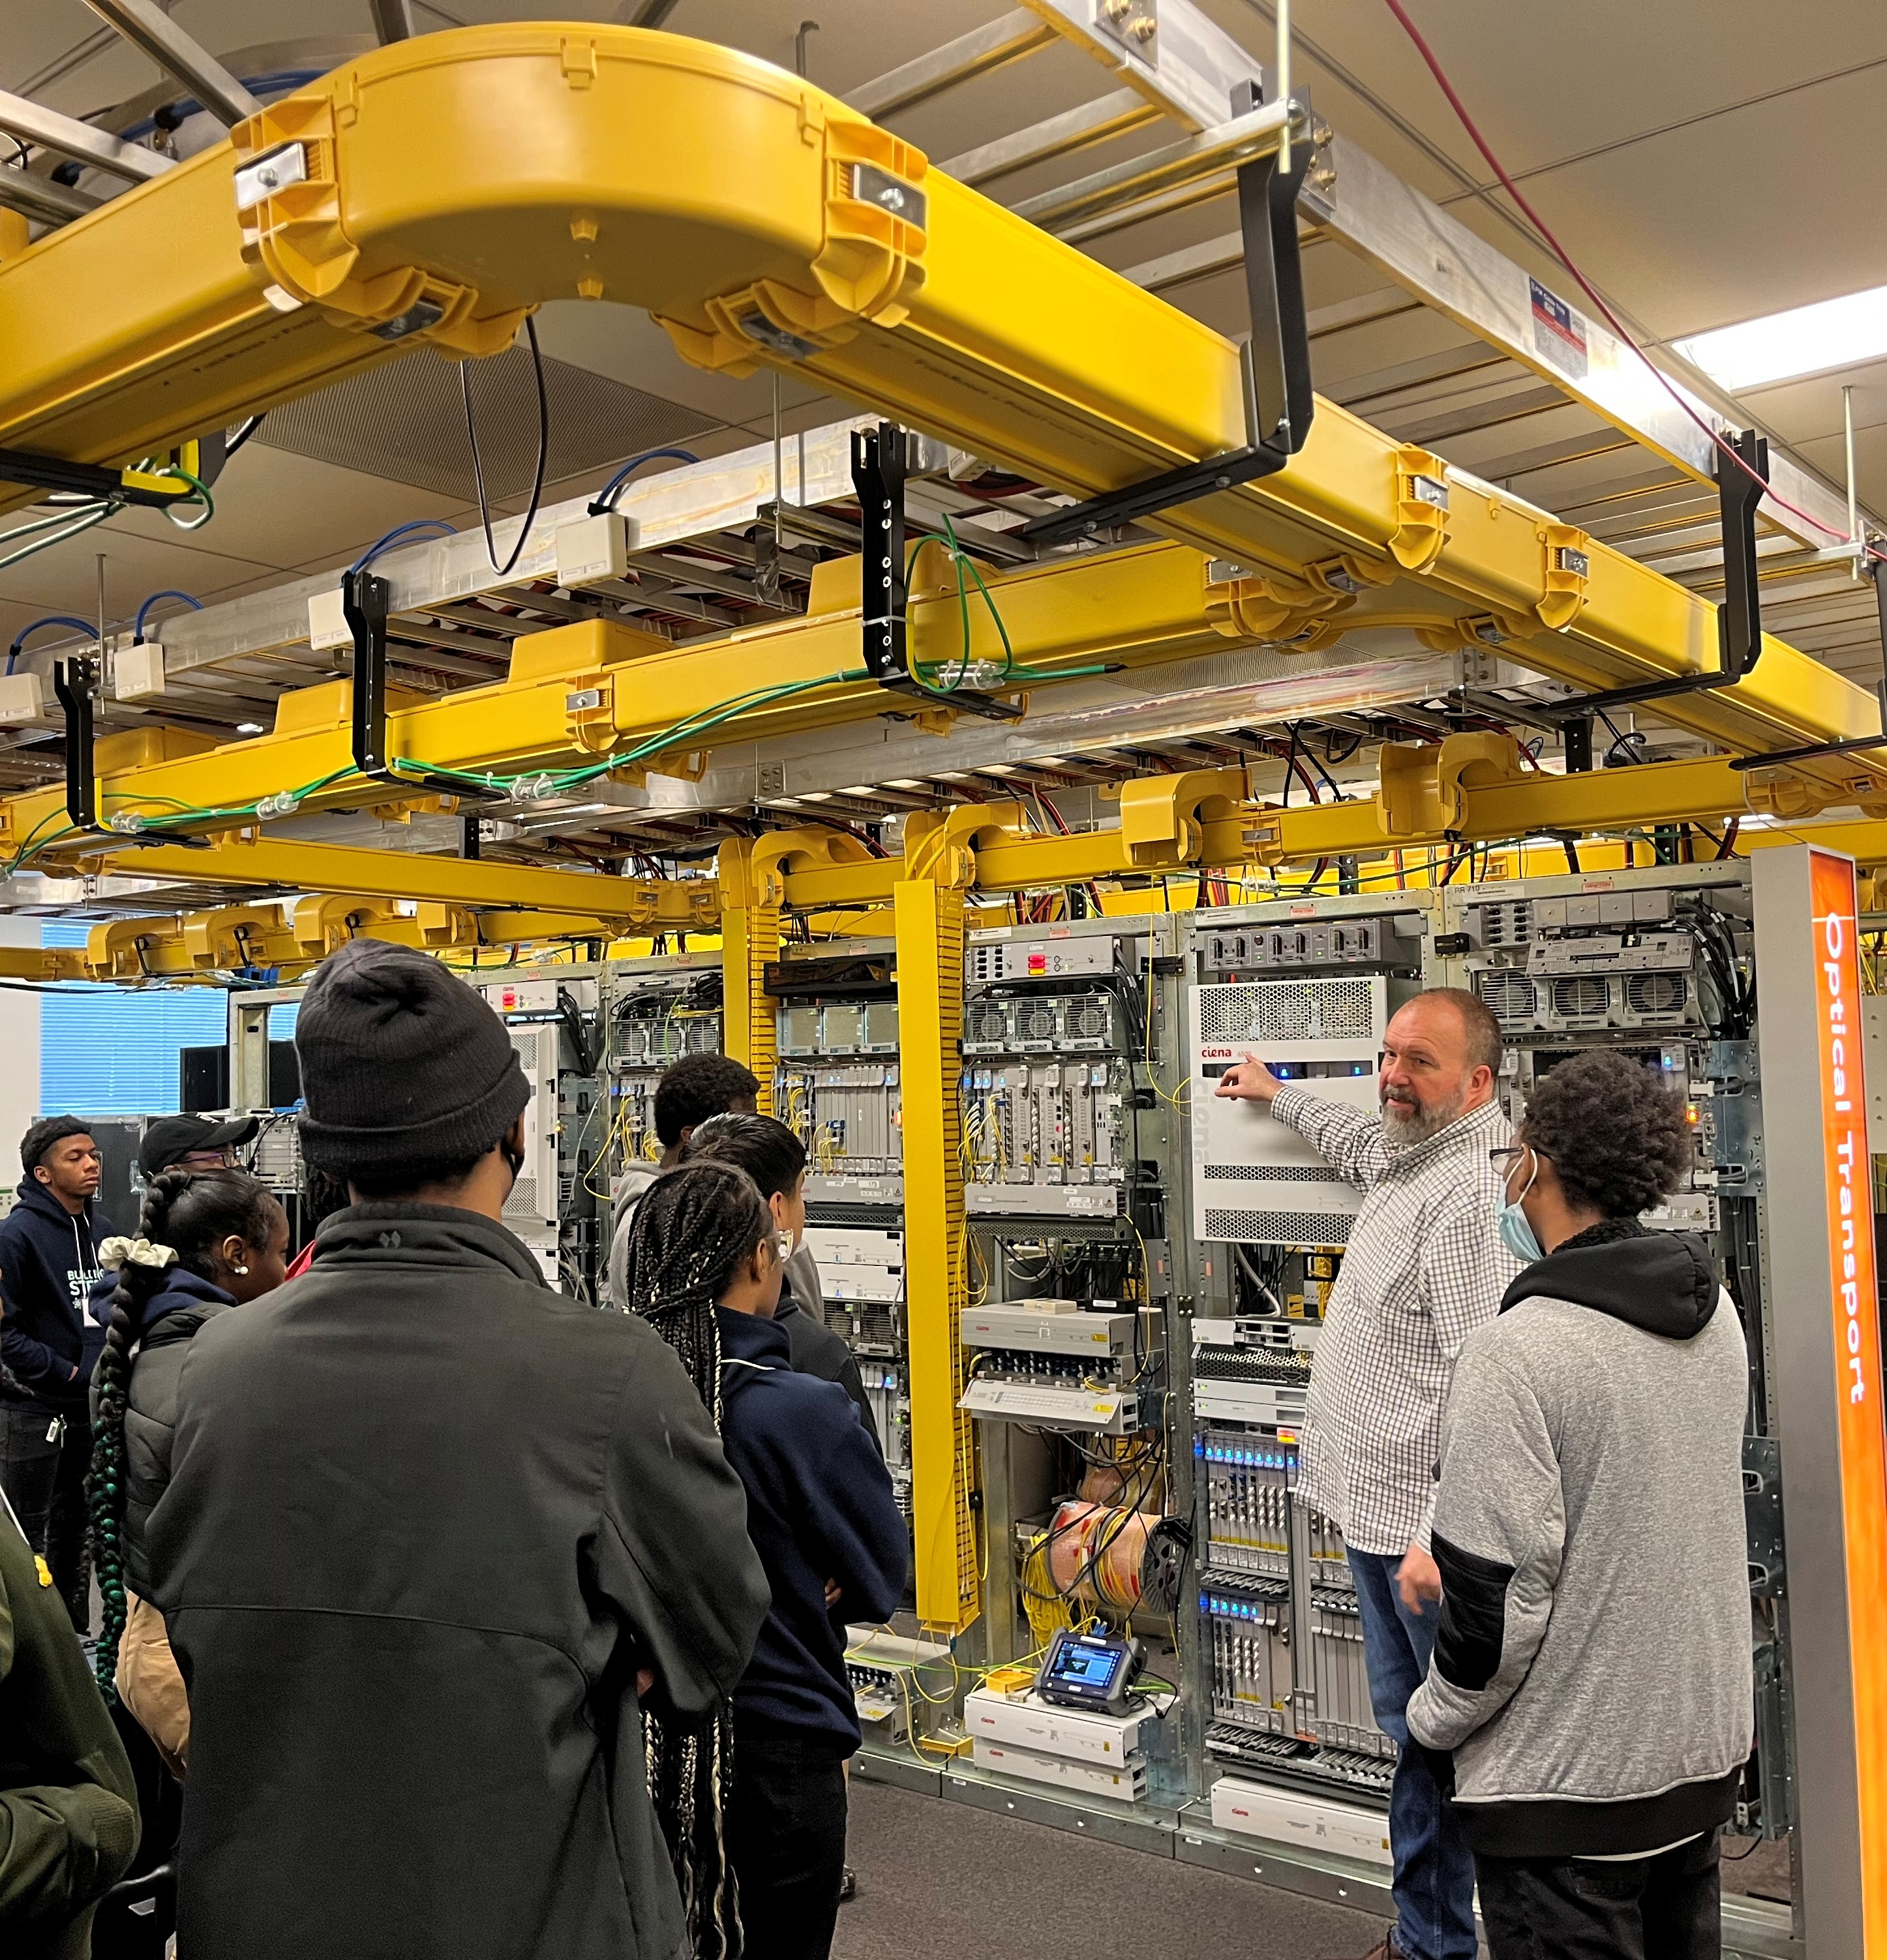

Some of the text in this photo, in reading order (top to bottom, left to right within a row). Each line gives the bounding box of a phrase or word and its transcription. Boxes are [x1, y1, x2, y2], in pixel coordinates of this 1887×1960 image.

[1201, 1046, 1232, 1058] ciena
[1194, 1077, 1217, 1164] ciena
[1823, 912, 1865, 1404] Optical Transport
